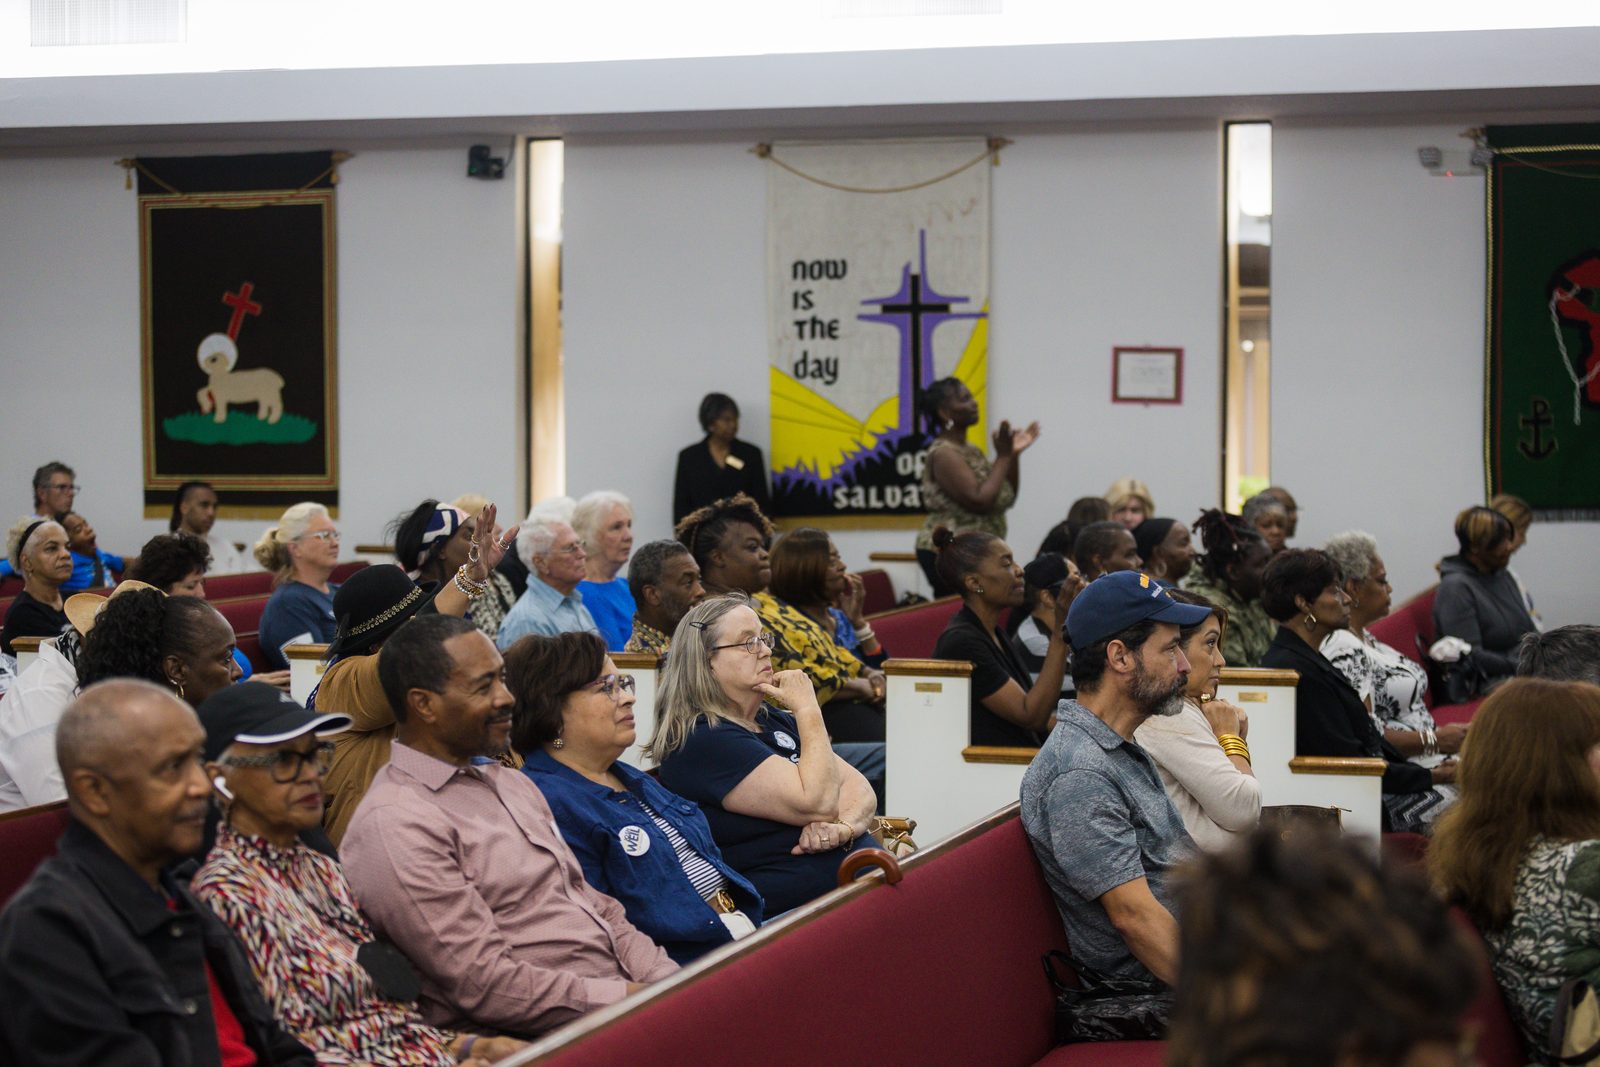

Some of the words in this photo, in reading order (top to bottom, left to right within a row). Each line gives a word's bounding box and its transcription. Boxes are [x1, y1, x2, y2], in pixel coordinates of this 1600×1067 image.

[794, 350, 839, 385] day
[896, 450, 928, 480] of
[626, 828, 640, 852] WEIL
